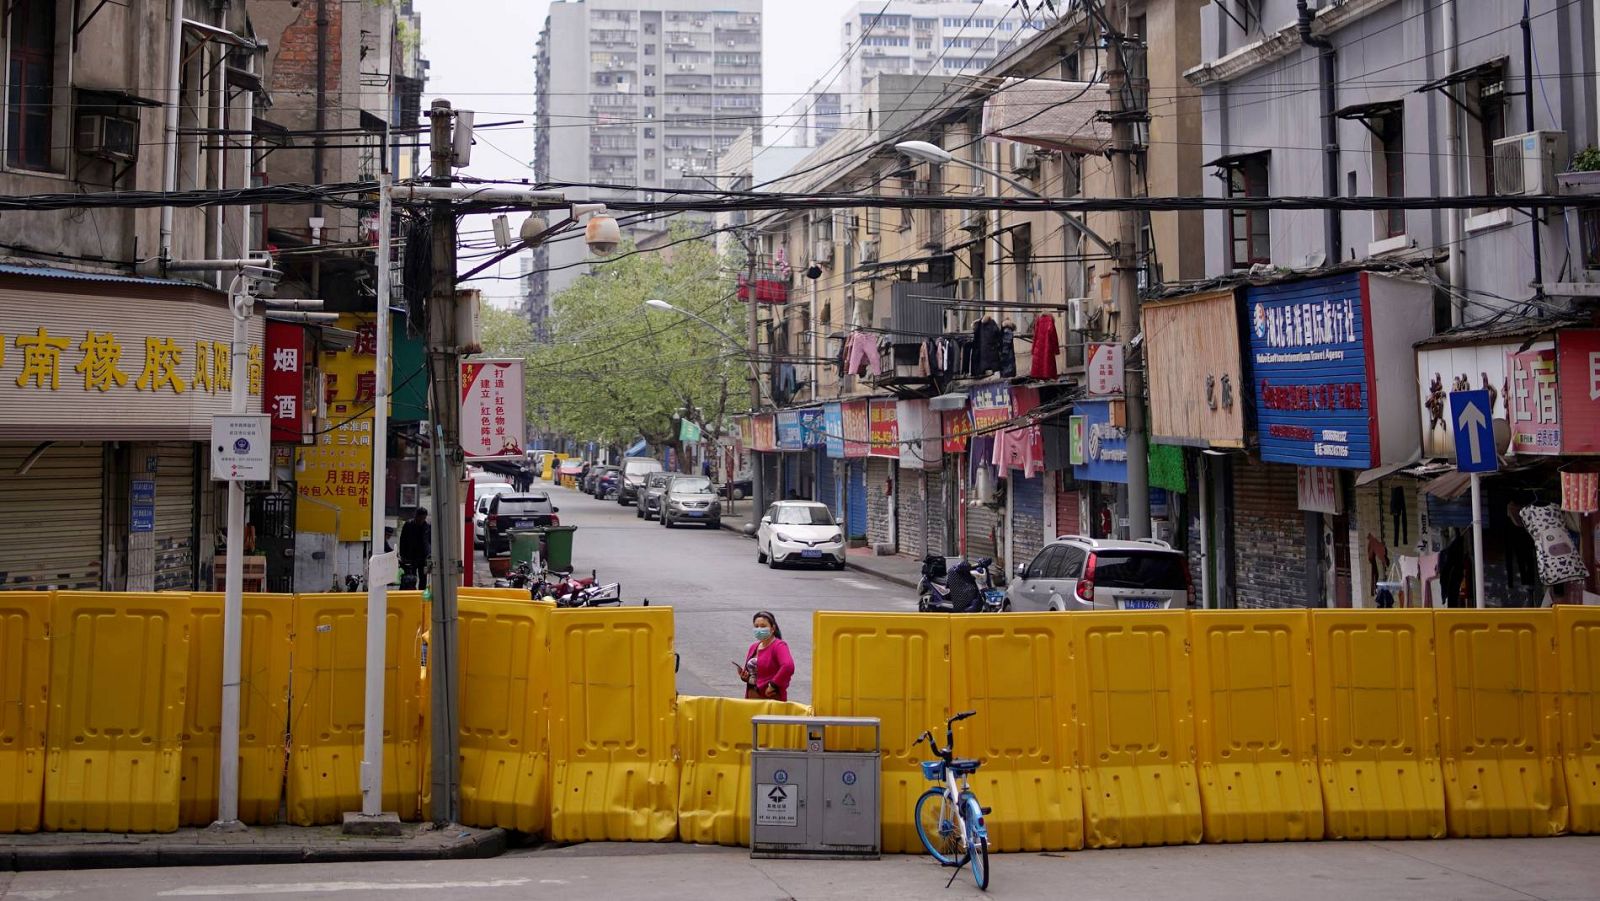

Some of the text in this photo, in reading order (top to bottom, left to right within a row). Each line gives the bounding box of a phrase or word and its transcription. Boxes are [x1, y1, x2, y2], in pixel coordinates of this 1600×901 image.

[0, 327, 186, 394] 南橡胶
[273, 347, 298, 419] 烟酒
[1511, 354, 1558, 424] 住宿
[337, 434, 370, 445] 三人间
[325, 470, 370, 485] 月租房
